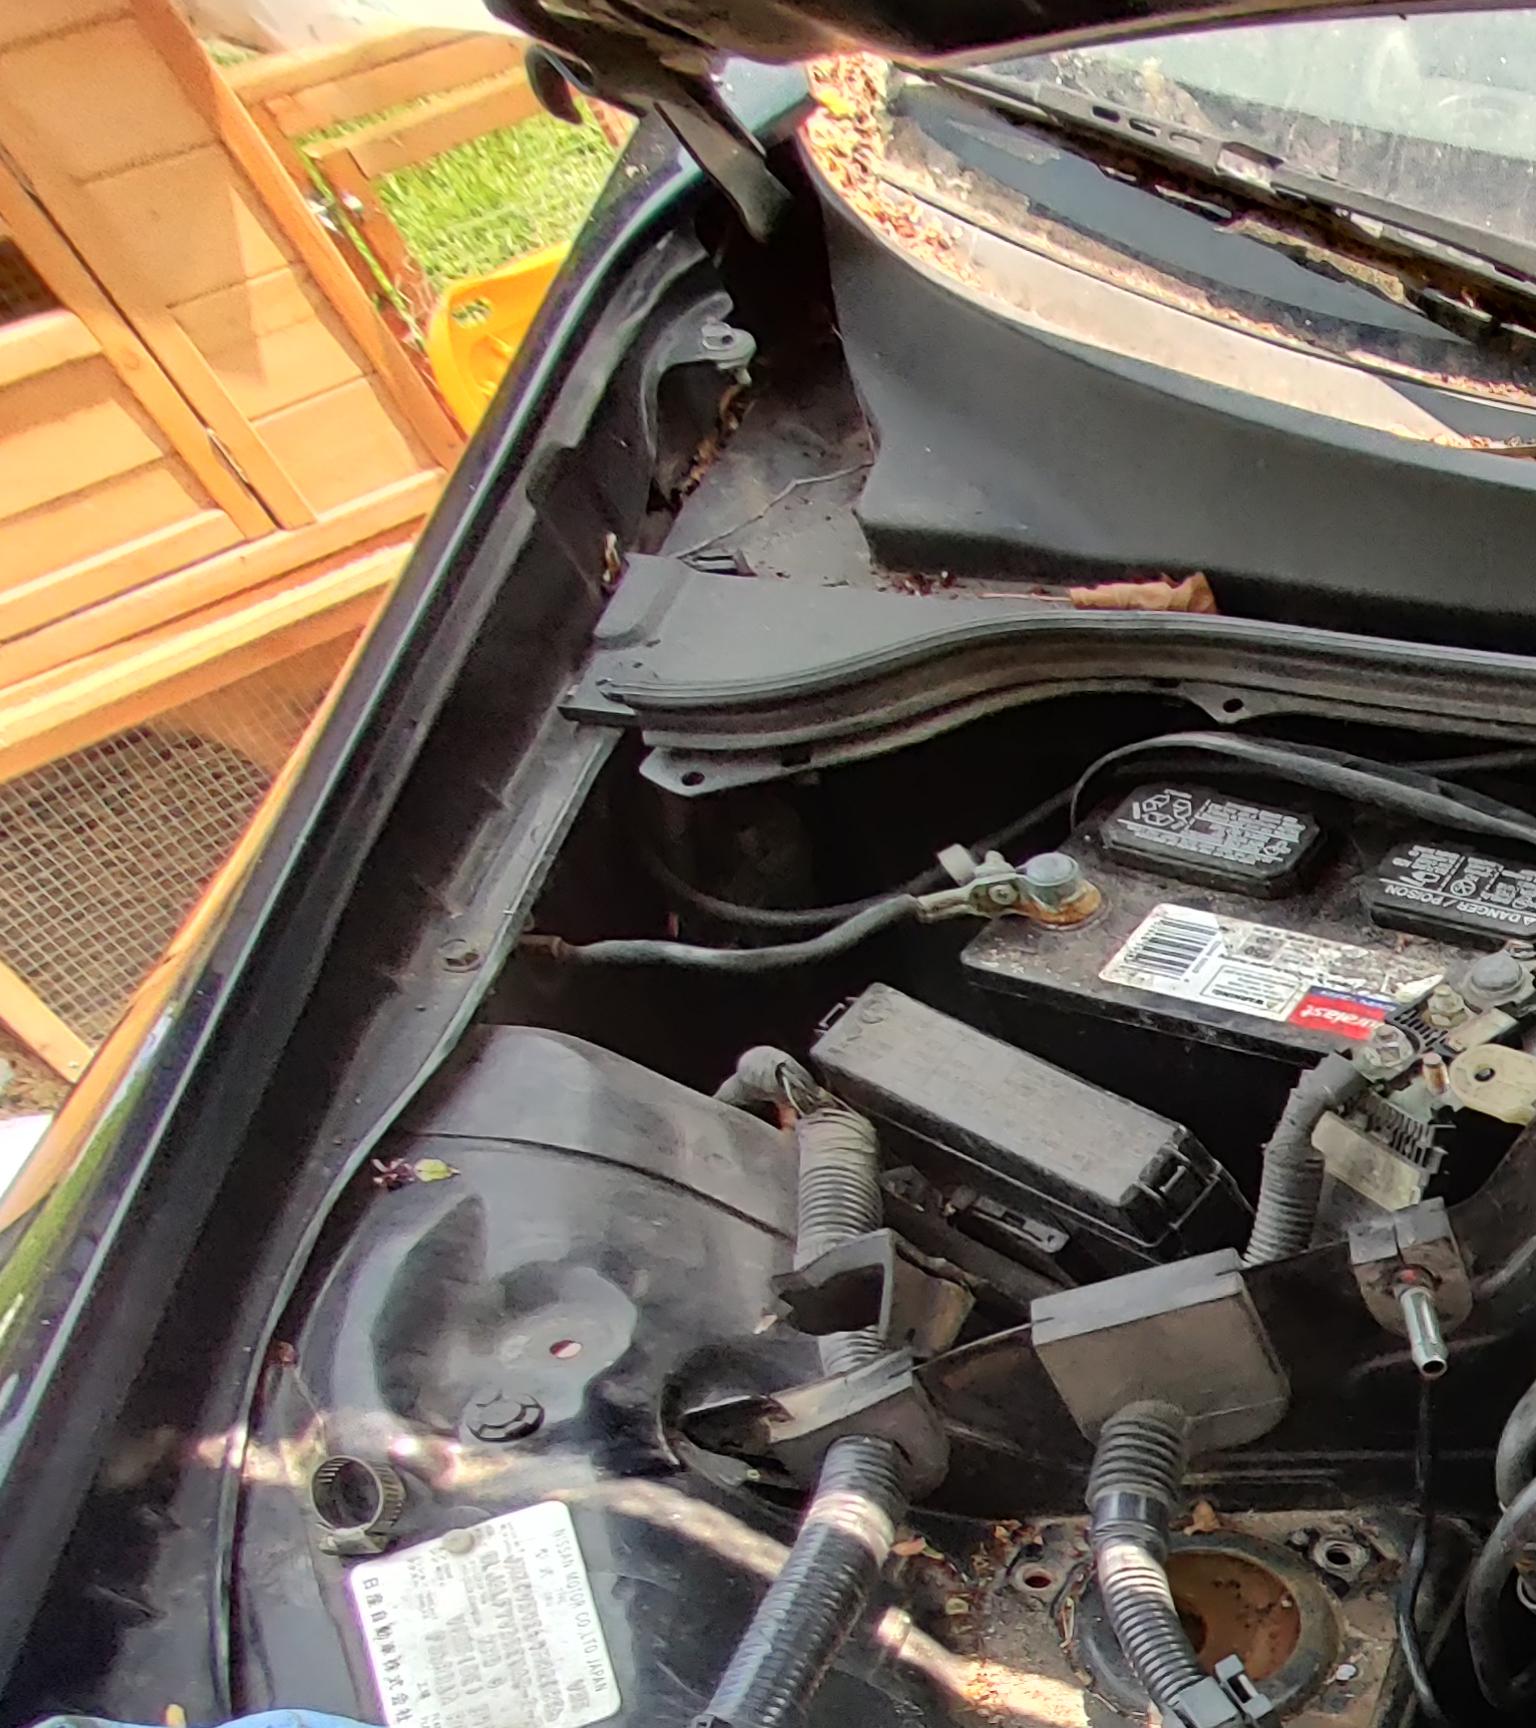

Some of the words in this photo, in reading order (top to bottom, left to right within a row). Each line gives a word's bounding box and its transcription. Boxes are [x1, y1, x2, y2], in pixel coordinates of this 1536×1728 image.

[1385, 884, 1444, 906] POISON
[1456, 901, 1522, 924] DANGER
[1301, 1004, 1386, 1029] uralast
[554, 1527, 575, 1568] NISSAN
[566, 1571, 586, 1609] MOTOR
[586, 1659, 608, 1693] JAPAN
